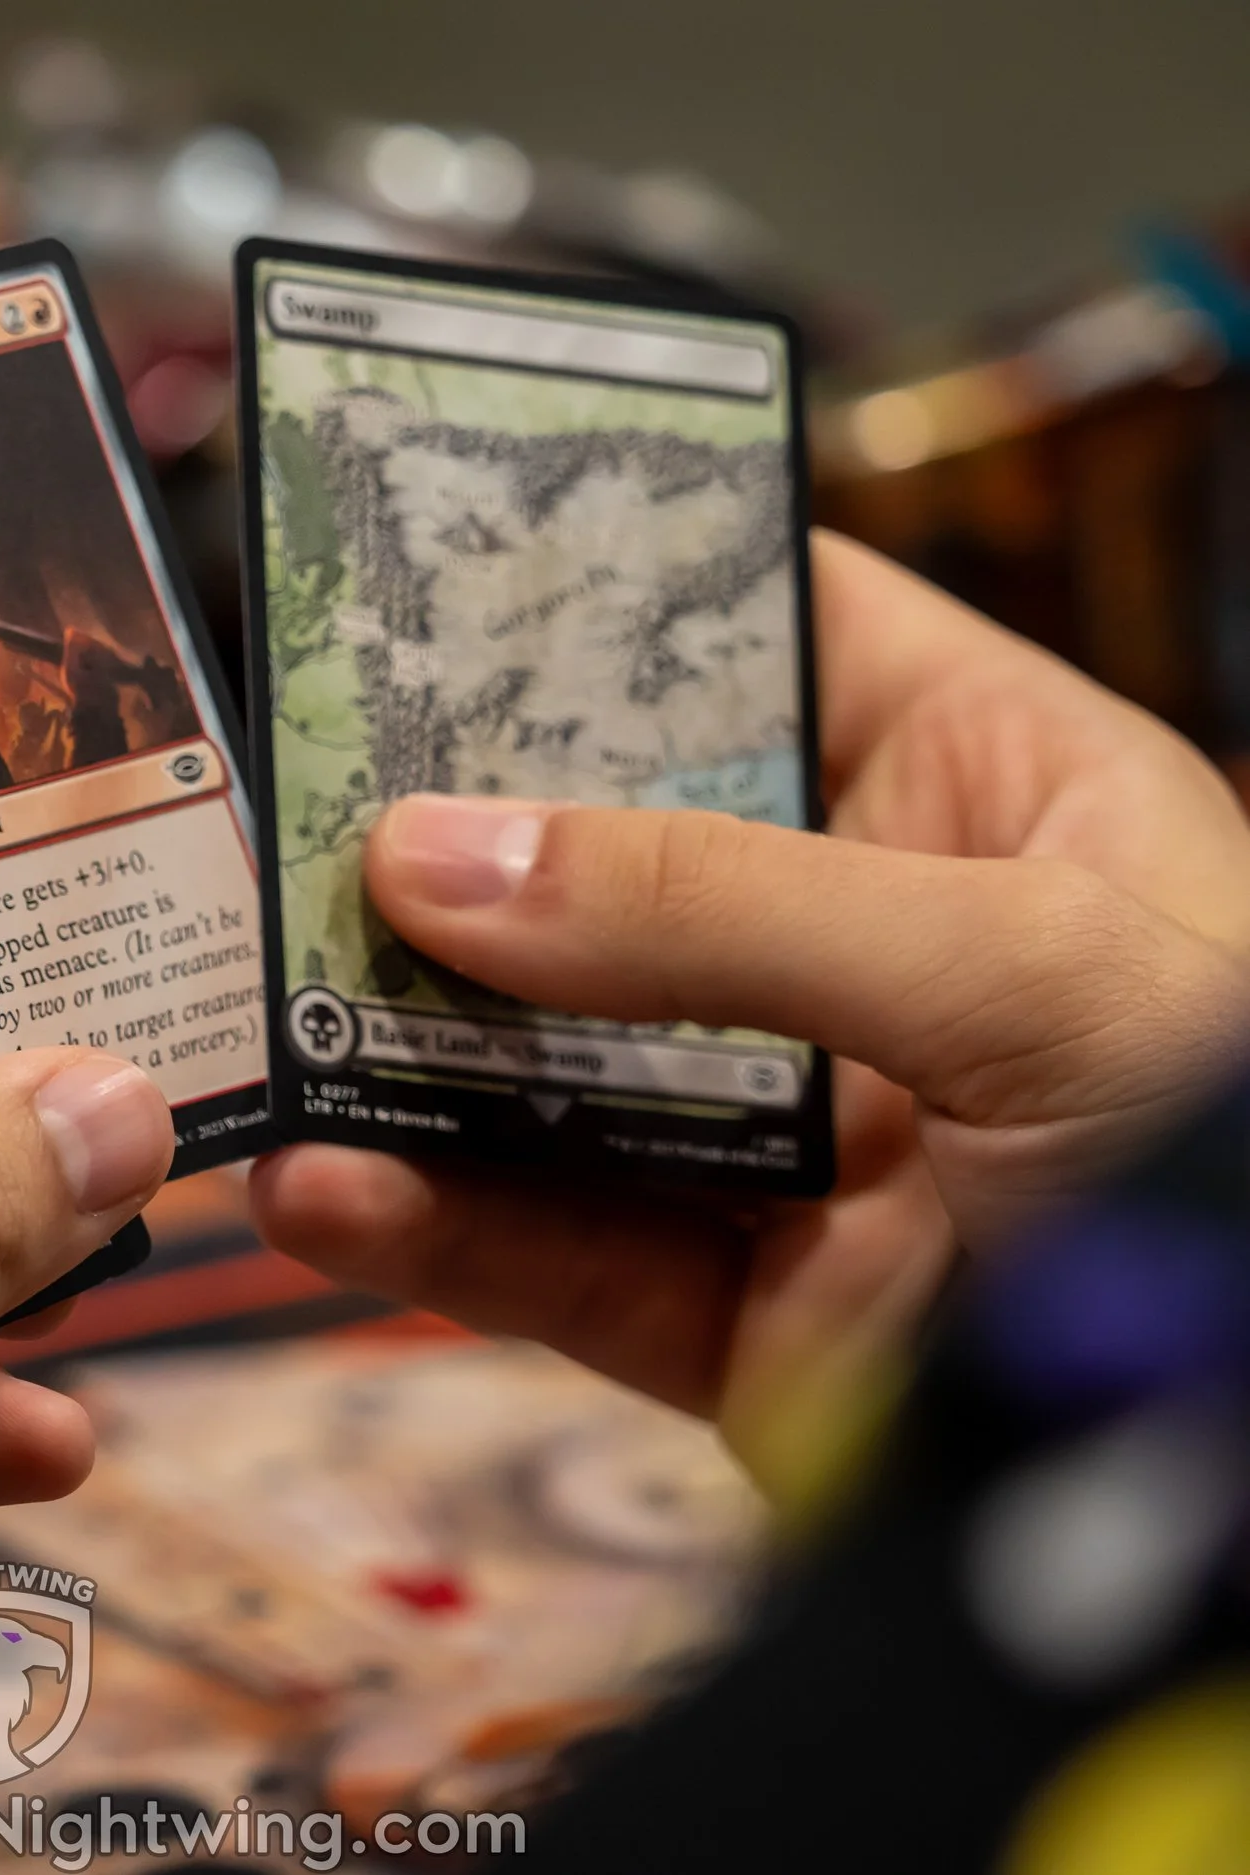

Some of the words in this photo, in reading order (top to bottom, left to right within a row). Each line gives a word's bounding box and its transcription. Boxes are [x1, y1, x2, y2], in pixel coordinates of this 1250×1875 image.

[281, 295, 378, 334] Swamp
[22, 875, 69, 915] gets
[74, 849, 155, 890] +3/+0.
[56, 901, 149, 942] creature
[155, 889, 176, 914] is
[21, 946, 117, 988] menace.
[124, 928, 154, 964] (It
[160, 911, 213, 948] can't
[219, 905, 242, 932] be
[28, 993, 66, 1021] two
[73, 986, 95, 1009] or
[102, 969, 154, 1001] more
[88, 1029, 108, 1048] to
[115, 1008, 175, 1042] target
[148, 1052, 162, 1068] a
[170, 1012, 259, 1063] sorcery.)
